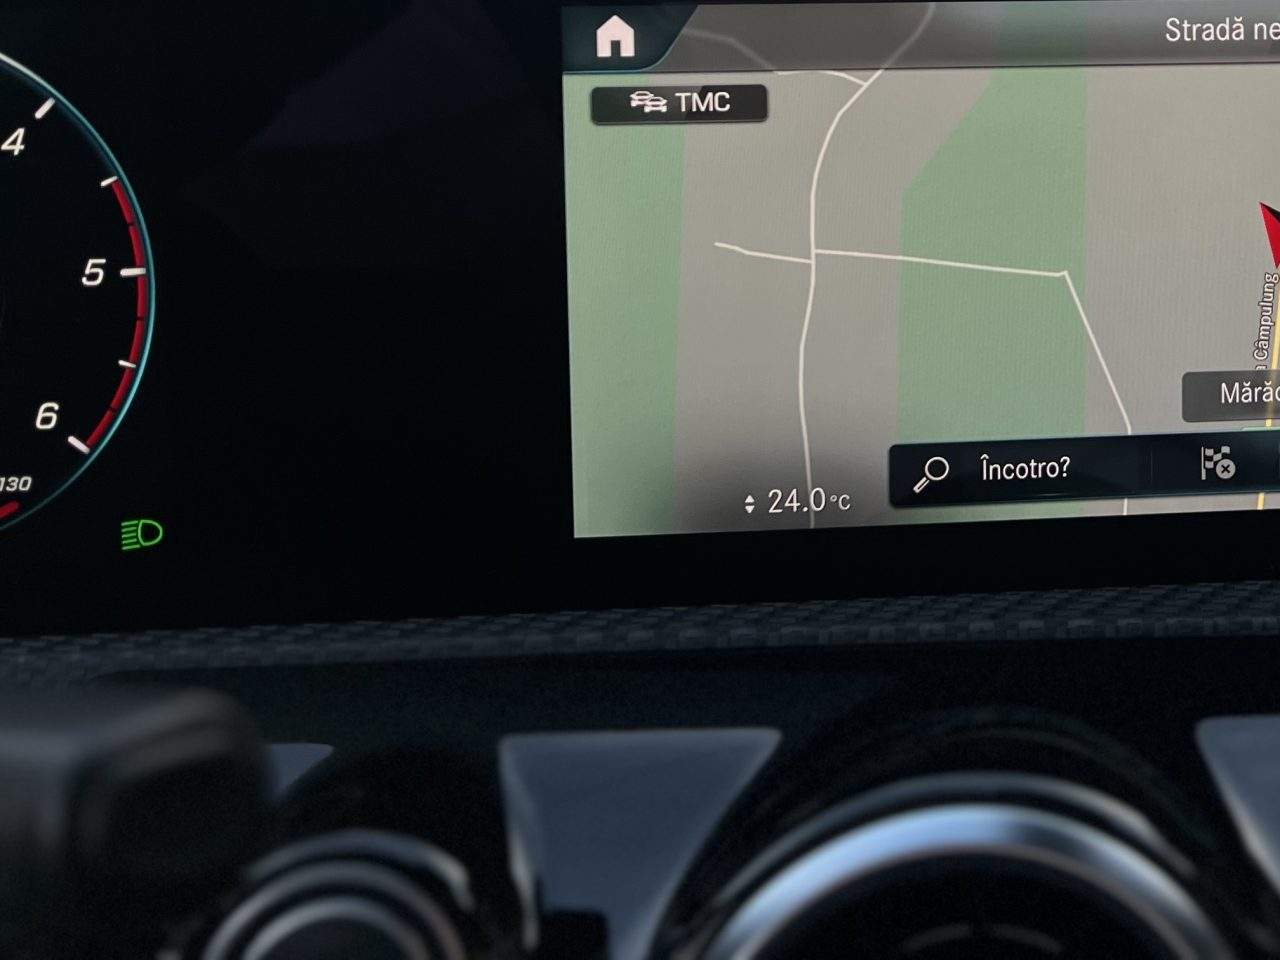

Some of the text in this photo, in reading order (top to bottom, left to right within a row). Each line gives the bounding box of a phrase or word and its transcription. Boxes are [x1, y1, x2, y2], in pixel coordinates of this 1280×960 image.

[1165, 16, 1245, 42] Stradă
[675, 91, 730, 112] TMC
[0, 127, 26, 156] 4
[81, 258, 106, 286] 5
[1253, 272, 1280, 360] Câmpulung
[35, 401, 60, 430] 6
[980, 454, 1071, 482] Încotro?
[0, 475, 33, 492] 130
